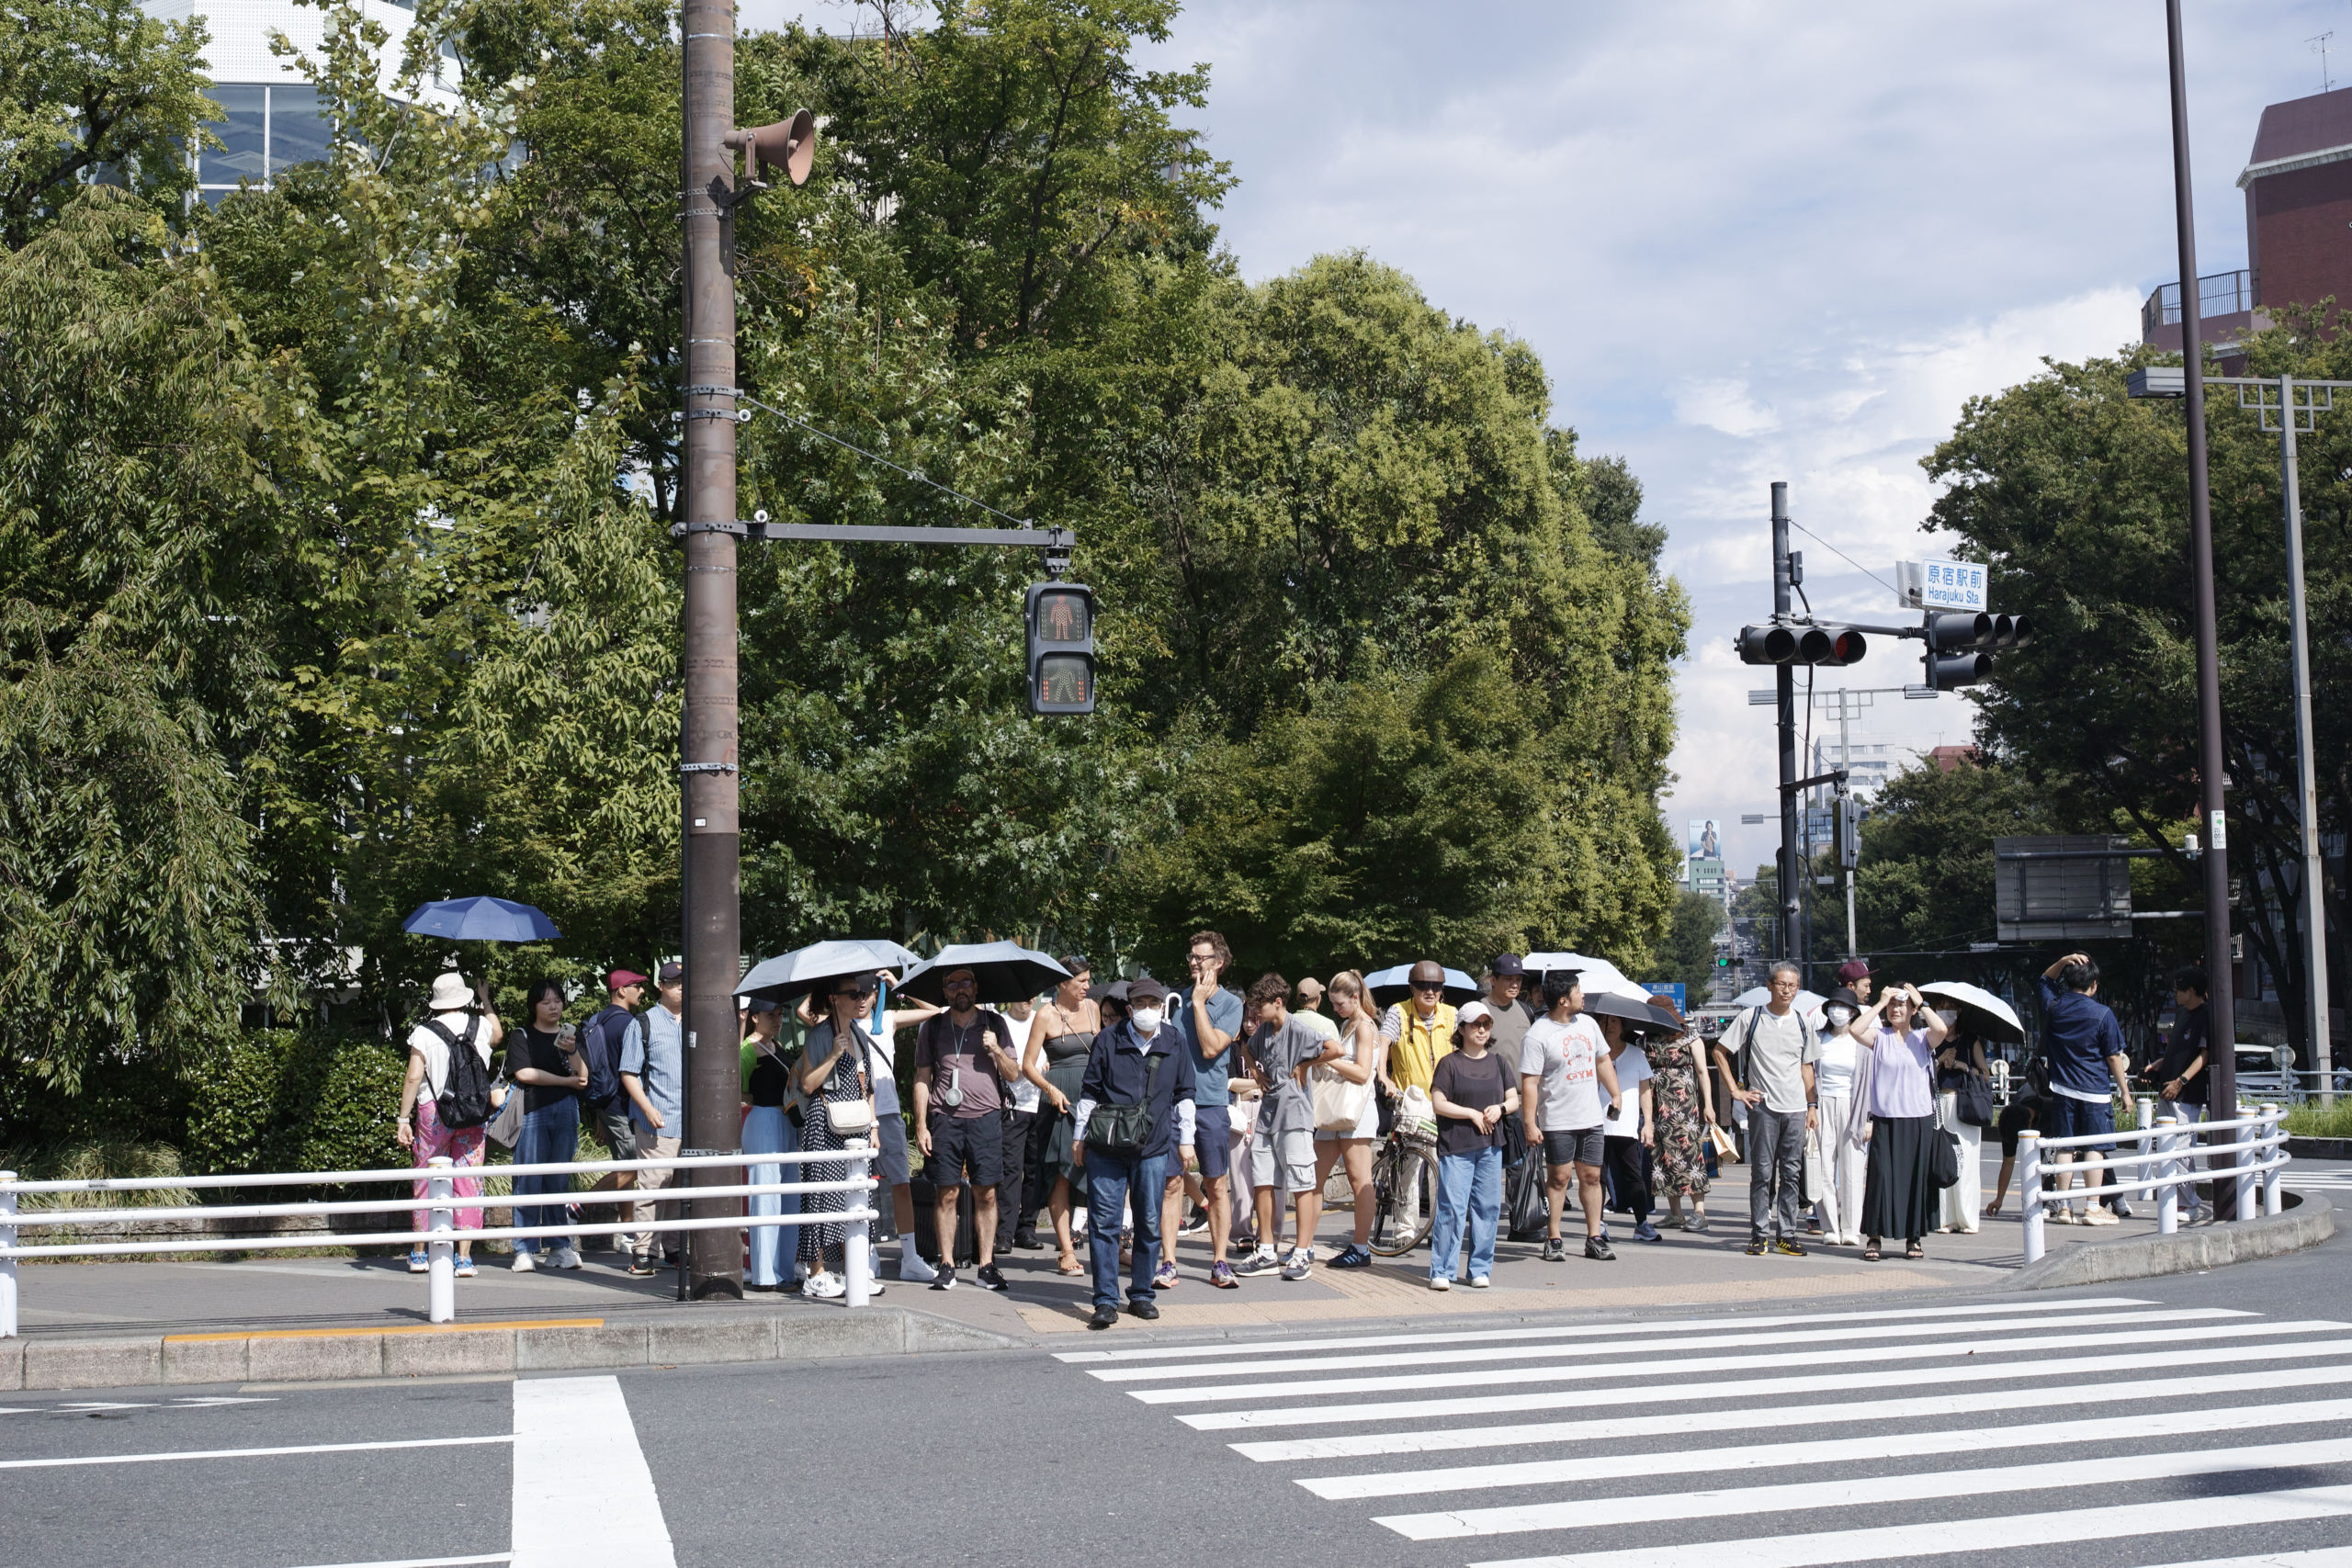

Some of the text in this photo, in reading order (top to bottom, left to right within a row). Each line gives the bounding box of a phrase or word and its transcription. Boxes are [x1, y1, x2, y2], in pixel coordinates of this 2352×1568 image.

[1928, 565, 1982, 589] 原宿駅前
[1928, 585, 1981, 604] Harajuku Sta.
[1563, 1032, 1592, 1058] GOLD'S
[1566, 1069, 1593, 1081] GYM
